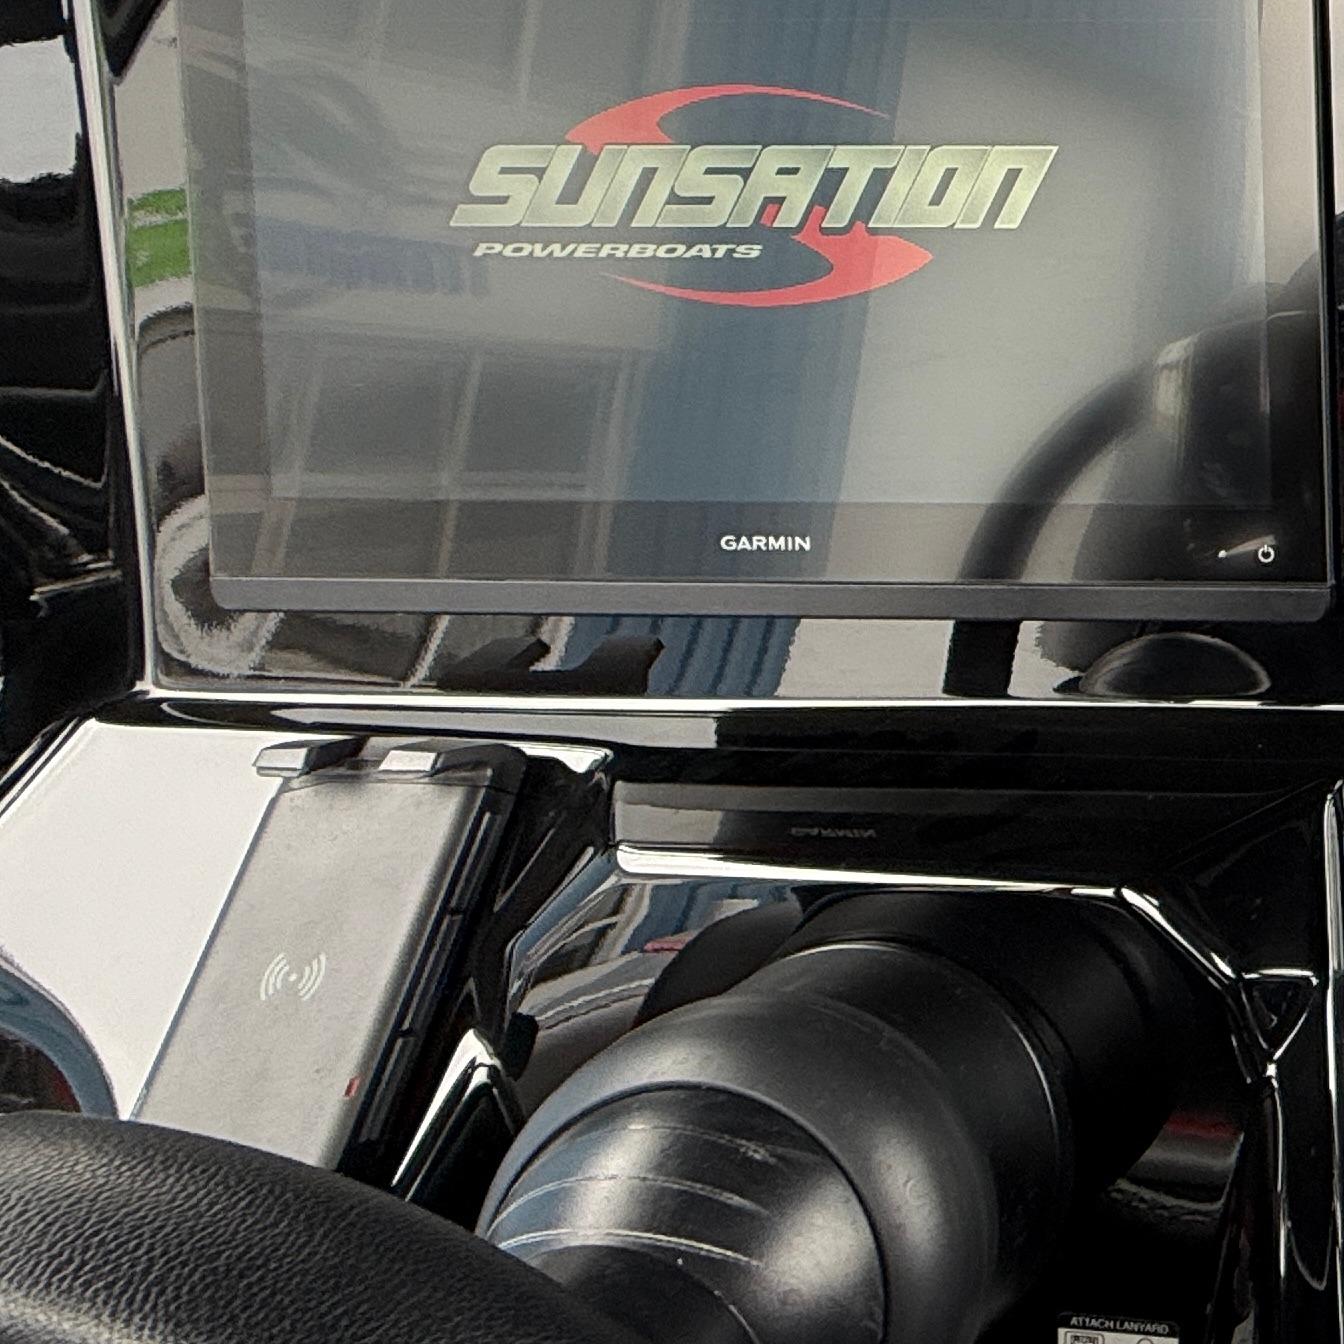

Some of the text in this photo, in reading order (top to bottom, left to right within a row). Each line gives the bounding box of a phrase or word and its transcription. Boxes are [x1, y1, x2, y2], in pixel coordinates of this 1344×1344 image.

[449, 144, 1060, 230] SUNSATION
[473, 242, 763, 259] POWERBOATS
[720, 535, 811, 551] GARMIN
[1070, 1317, 1169, 1334] ATTACH LANYARD
